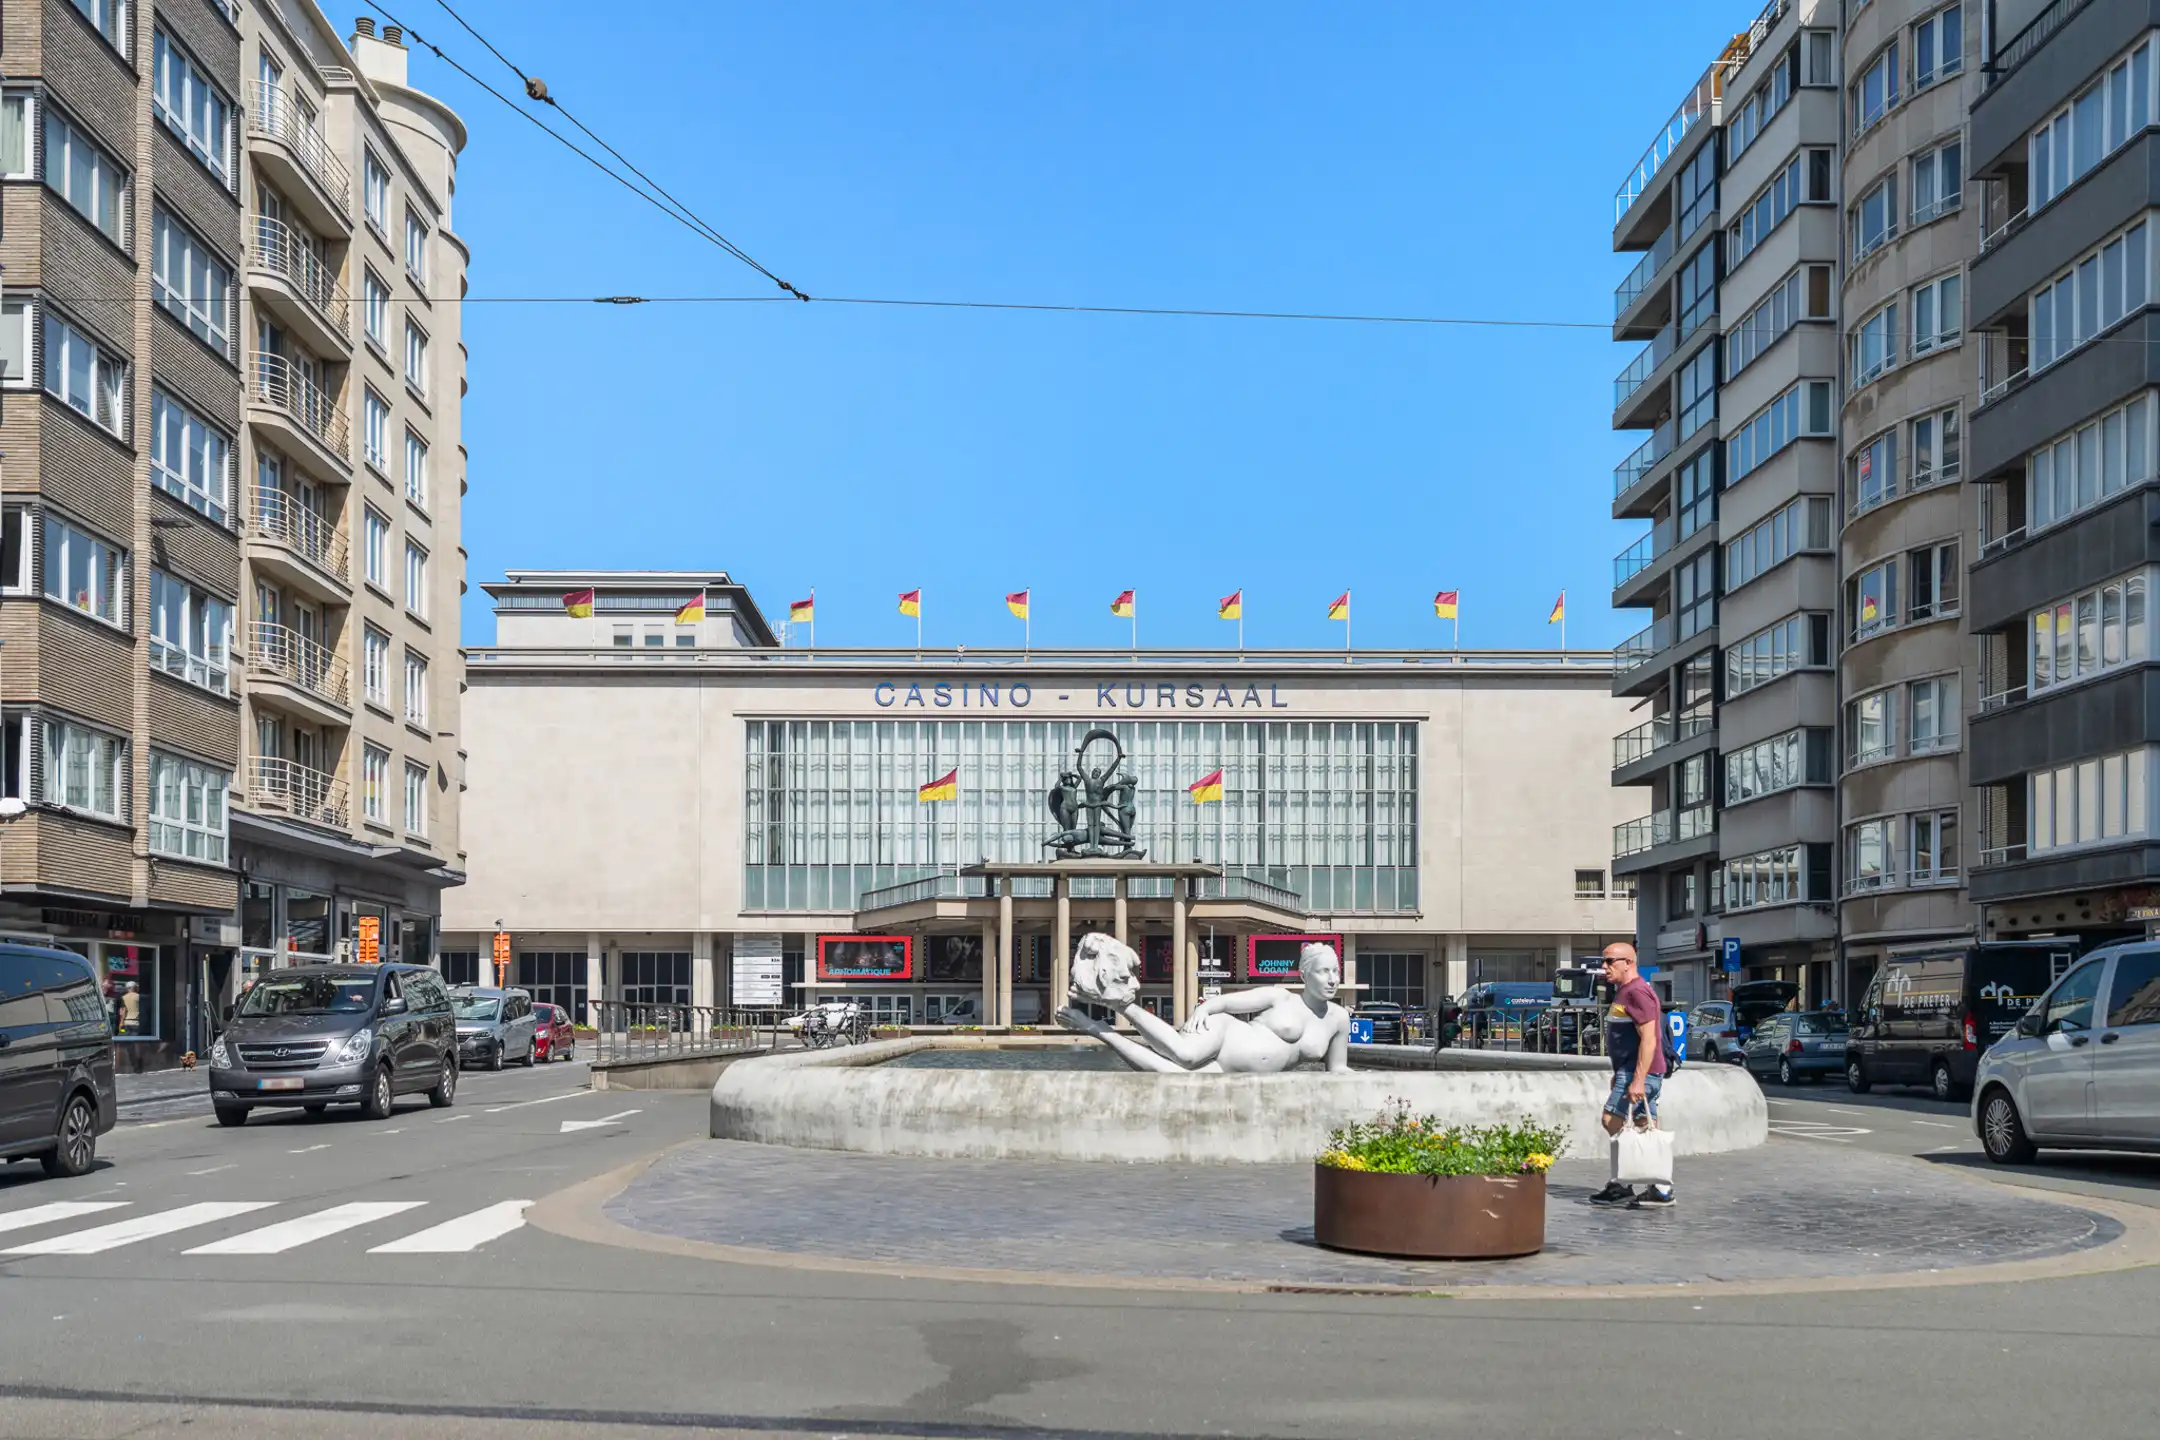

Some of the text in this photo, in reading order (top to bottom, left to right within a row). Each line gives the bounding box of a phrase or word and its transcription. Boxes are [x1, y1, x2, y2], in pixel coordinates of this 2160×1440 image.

[874, 683, 1032, 707] CASINO
[1097, 683, 1288, 707] KURSAAL
[1725, 941, 1738, 960] P
[1259, 959, 1294, 967] JOHNNY
[1904, 996, 1915, 1008] DE
[1918, 995, 1951, 1008] PRETER
[2007, 998, 2021, 1006] DE
